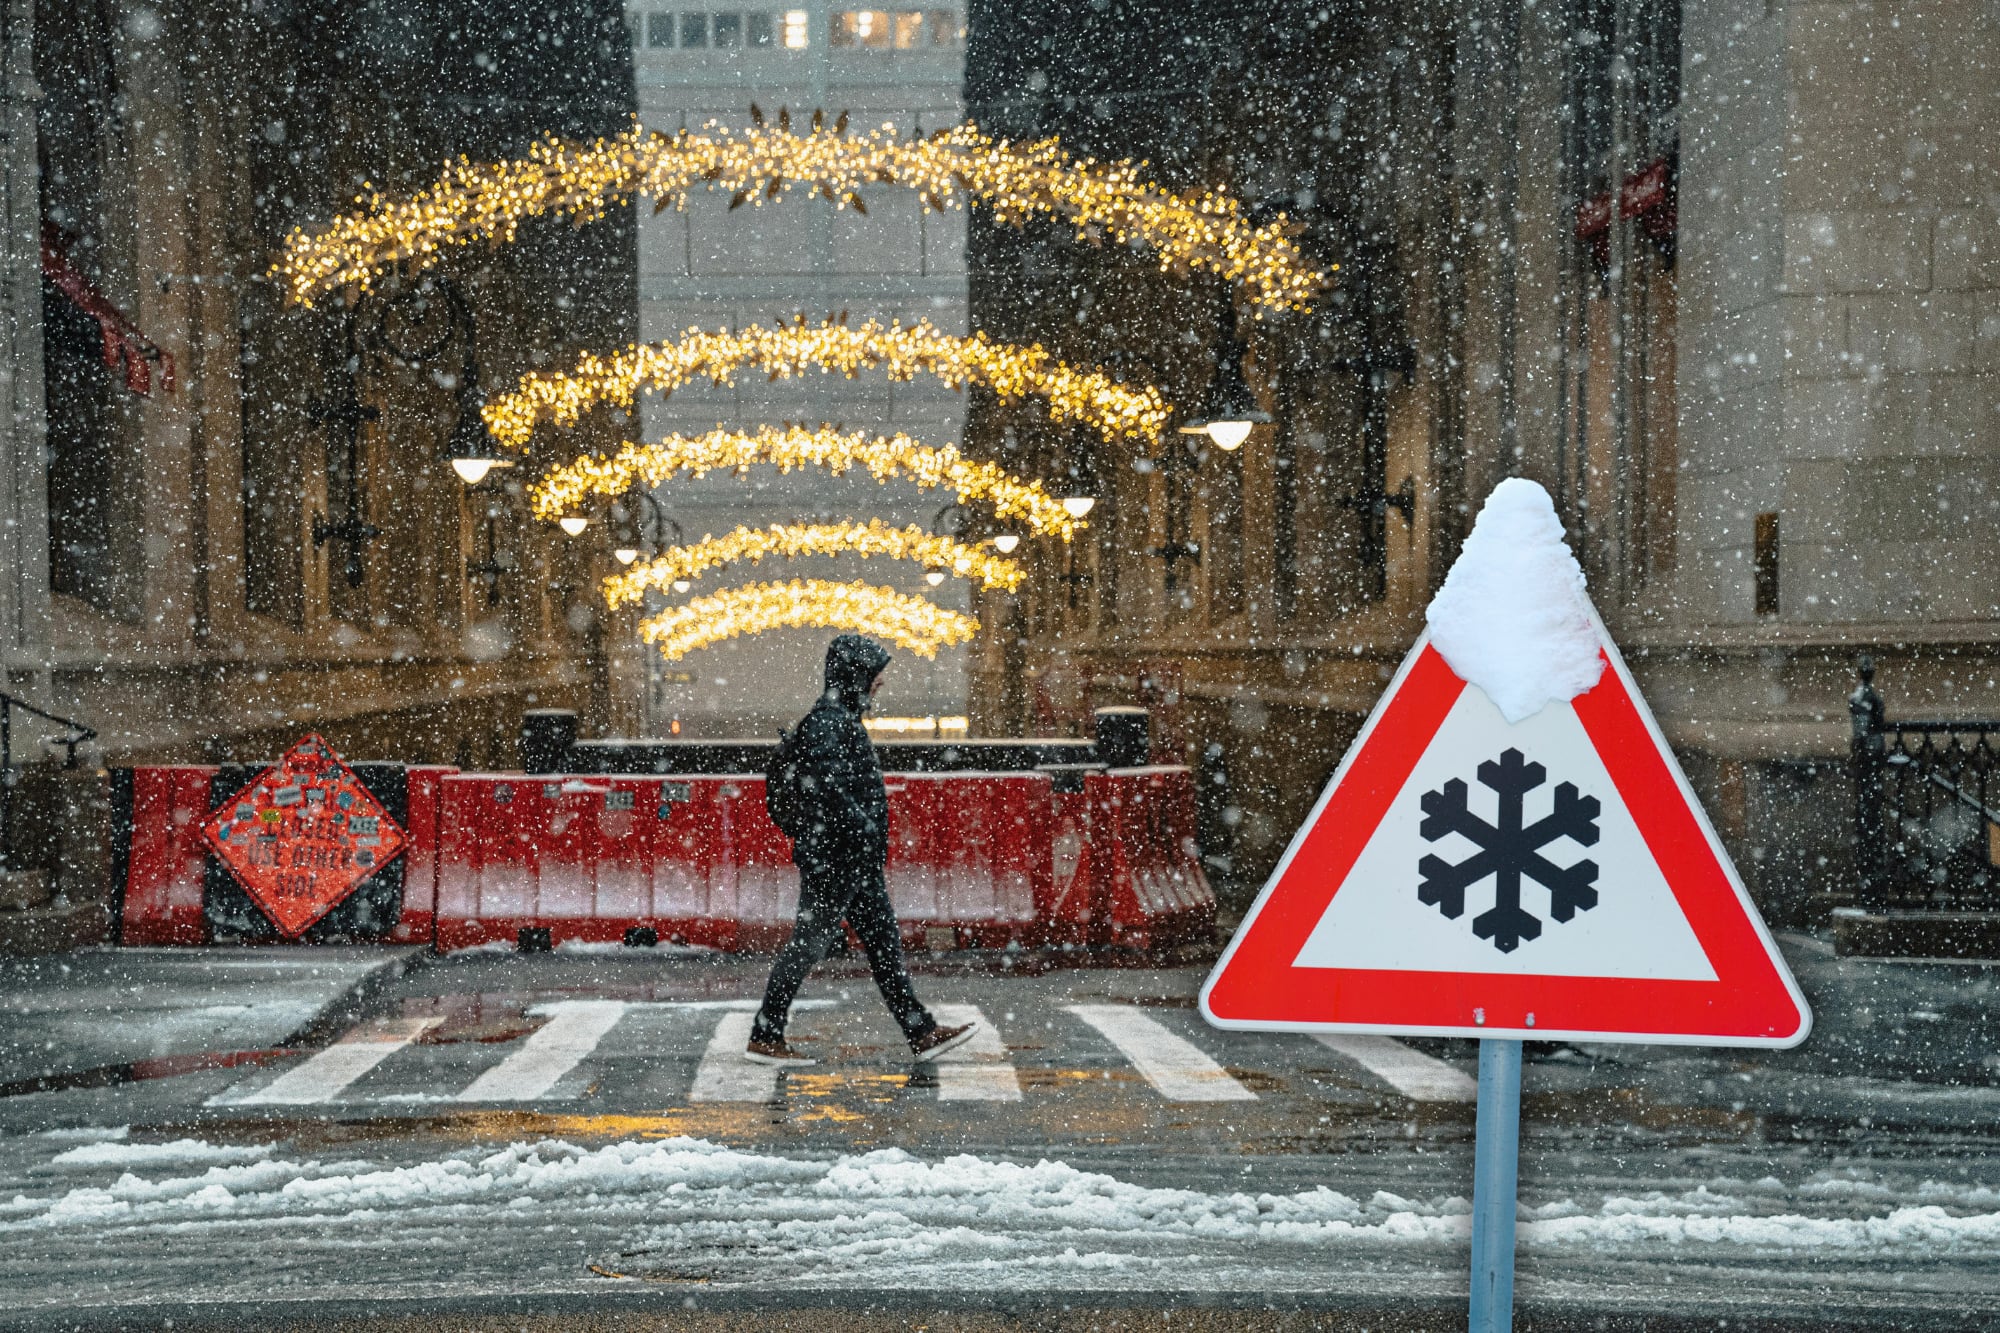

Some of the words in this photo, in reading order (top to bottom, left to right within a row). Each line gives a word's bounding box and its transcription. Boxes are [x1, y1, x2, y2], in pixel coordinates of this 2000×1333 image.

[248, 840, 281, 868] USE
[292, 845, 353, 869] OTHER
[276, 873, 316, 898] SIDE
